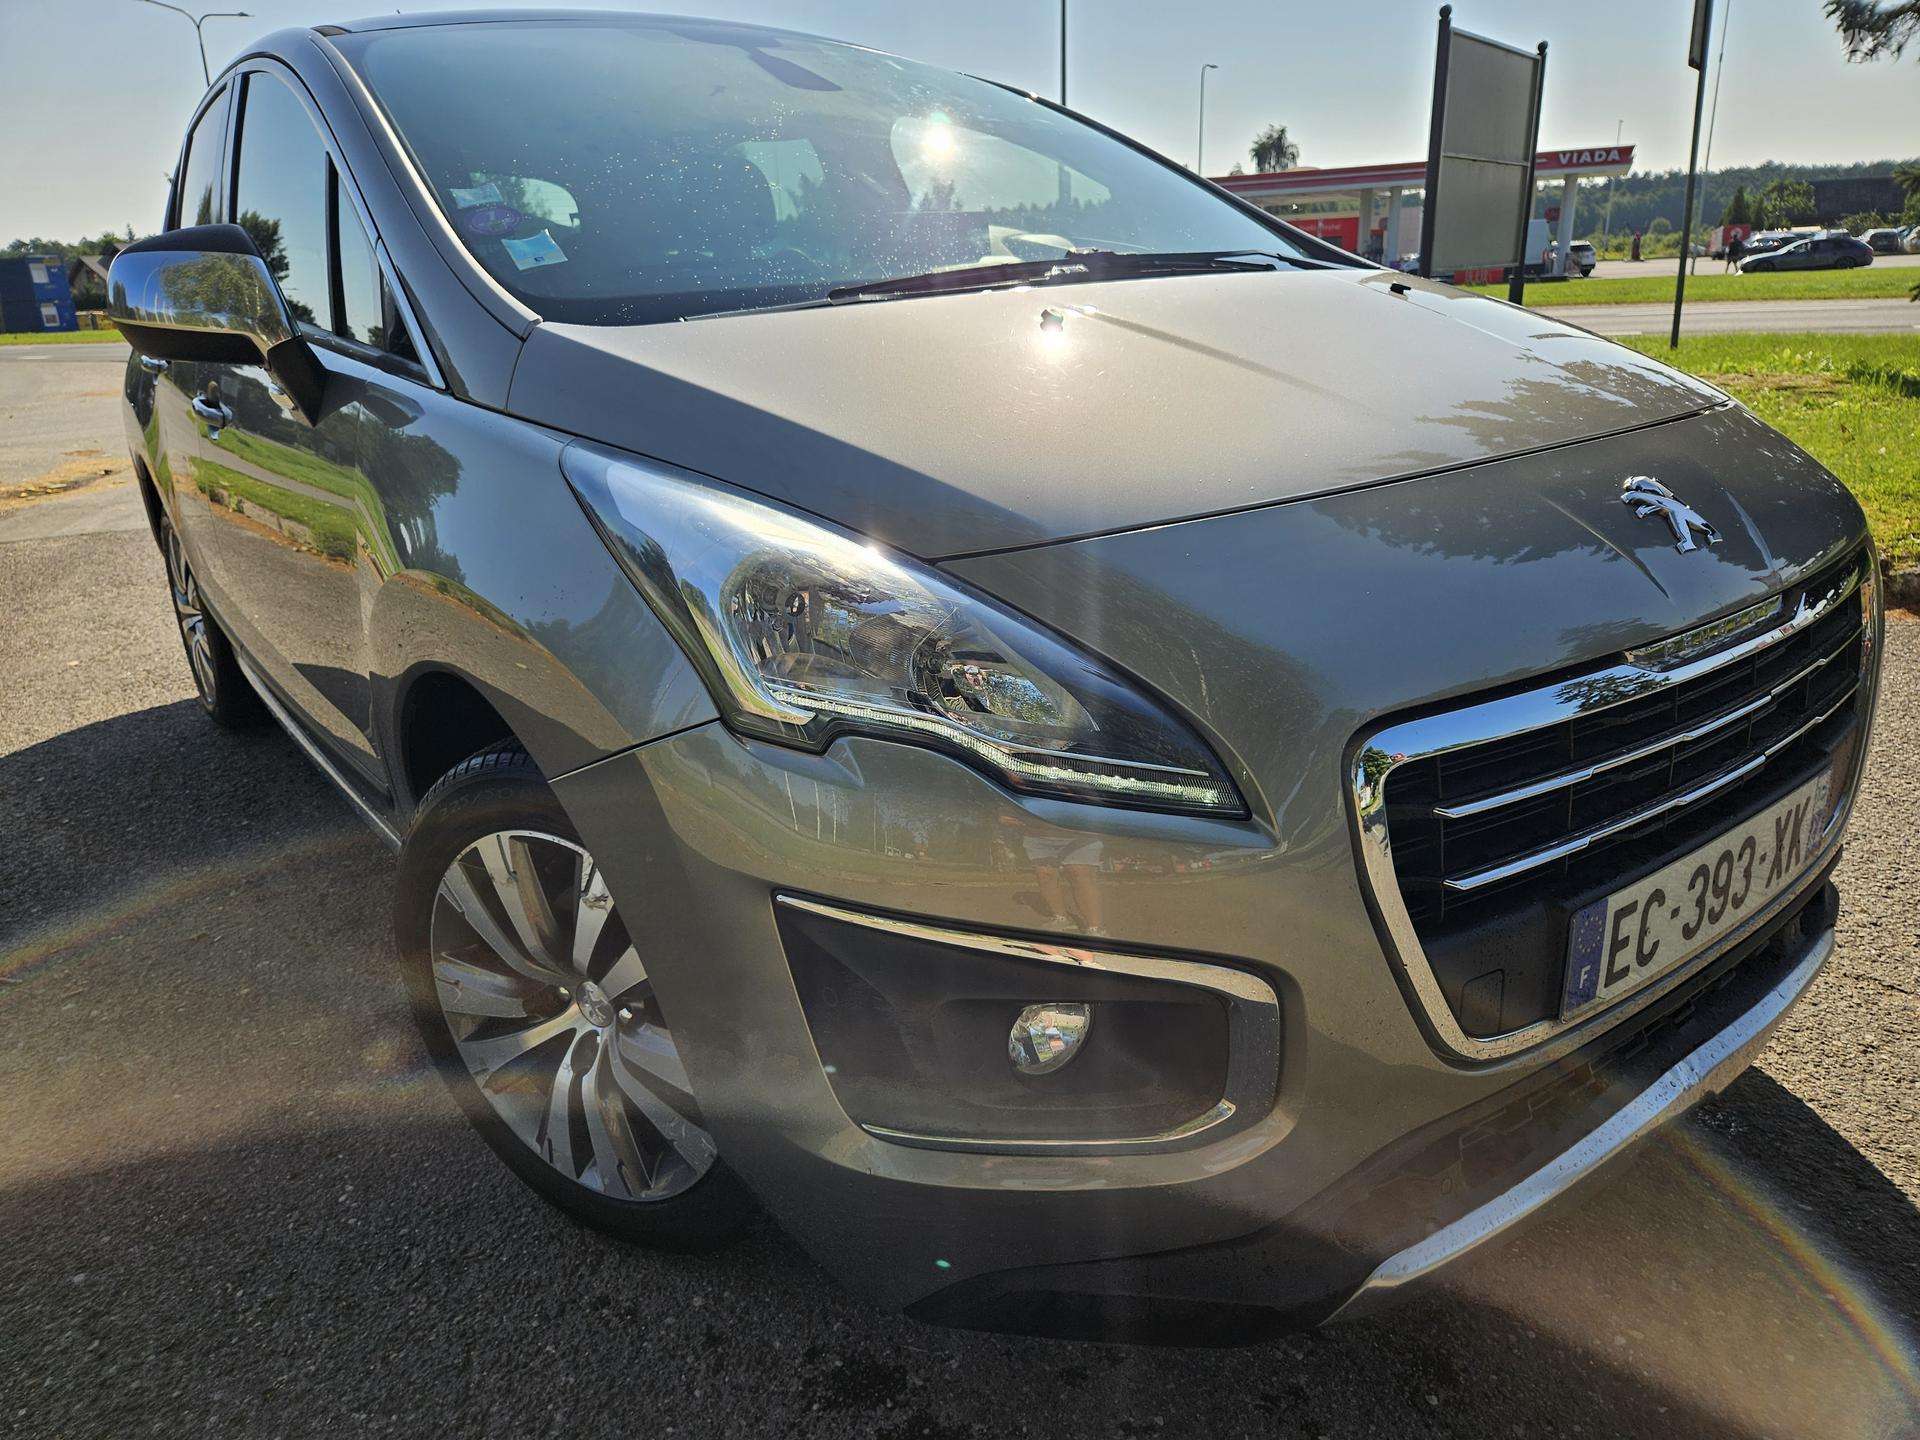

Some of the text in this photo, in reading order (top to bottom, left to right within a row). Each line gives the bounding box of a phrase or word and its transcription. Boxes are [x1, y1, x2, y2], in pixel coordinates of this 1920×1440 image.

[1559, 149, 1620, 165] VIADA
[1604, 797, 1811, 988] EC-393-XK
[1580, 964, 1591, 989] F
